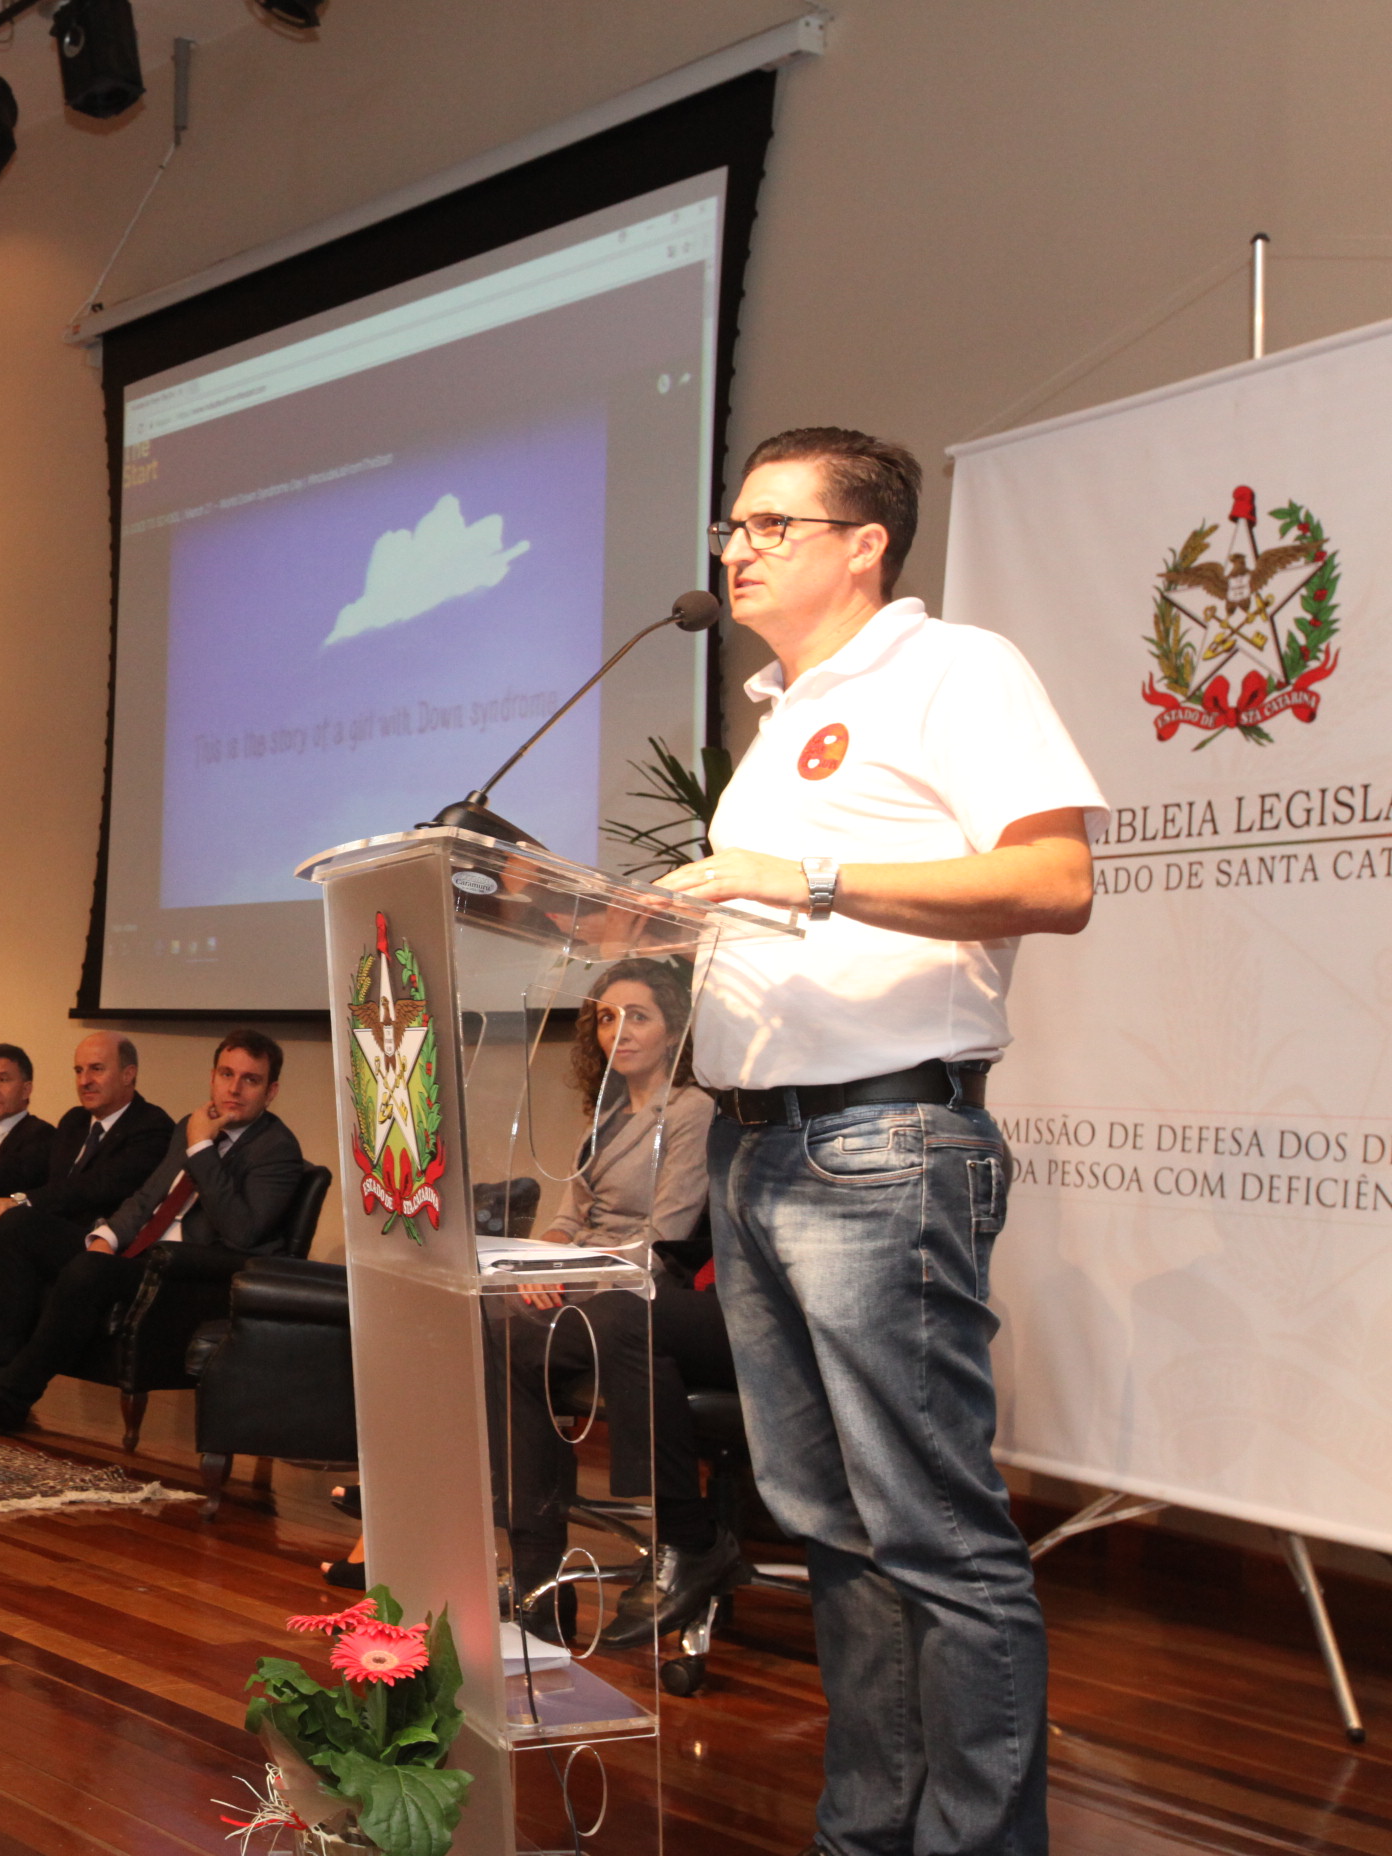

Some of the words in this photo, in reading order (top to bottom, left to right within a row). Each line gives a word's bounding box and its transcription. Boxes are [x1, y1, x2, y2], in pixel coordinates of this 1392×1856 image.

[417, 700, 464, 735] Down
[468, 688, 559, 734] syndrome
[1093, 863, 1153, 895] ADO
[1164, 861, 1204, 892] DE
[1215, 849, 1320, 888] SANTA
[992, 1114, 1096, 1148] MISSÃO
[1108, 1121, 1145, 1150] DE
[1156, 1124, 1265, 1158] DEFESA
[1278, 1129, 1348, 1163] DOS
[1047, 1159, 1144, 1193] PESSOA
[1154, 1166, 1226, 1199] COM
